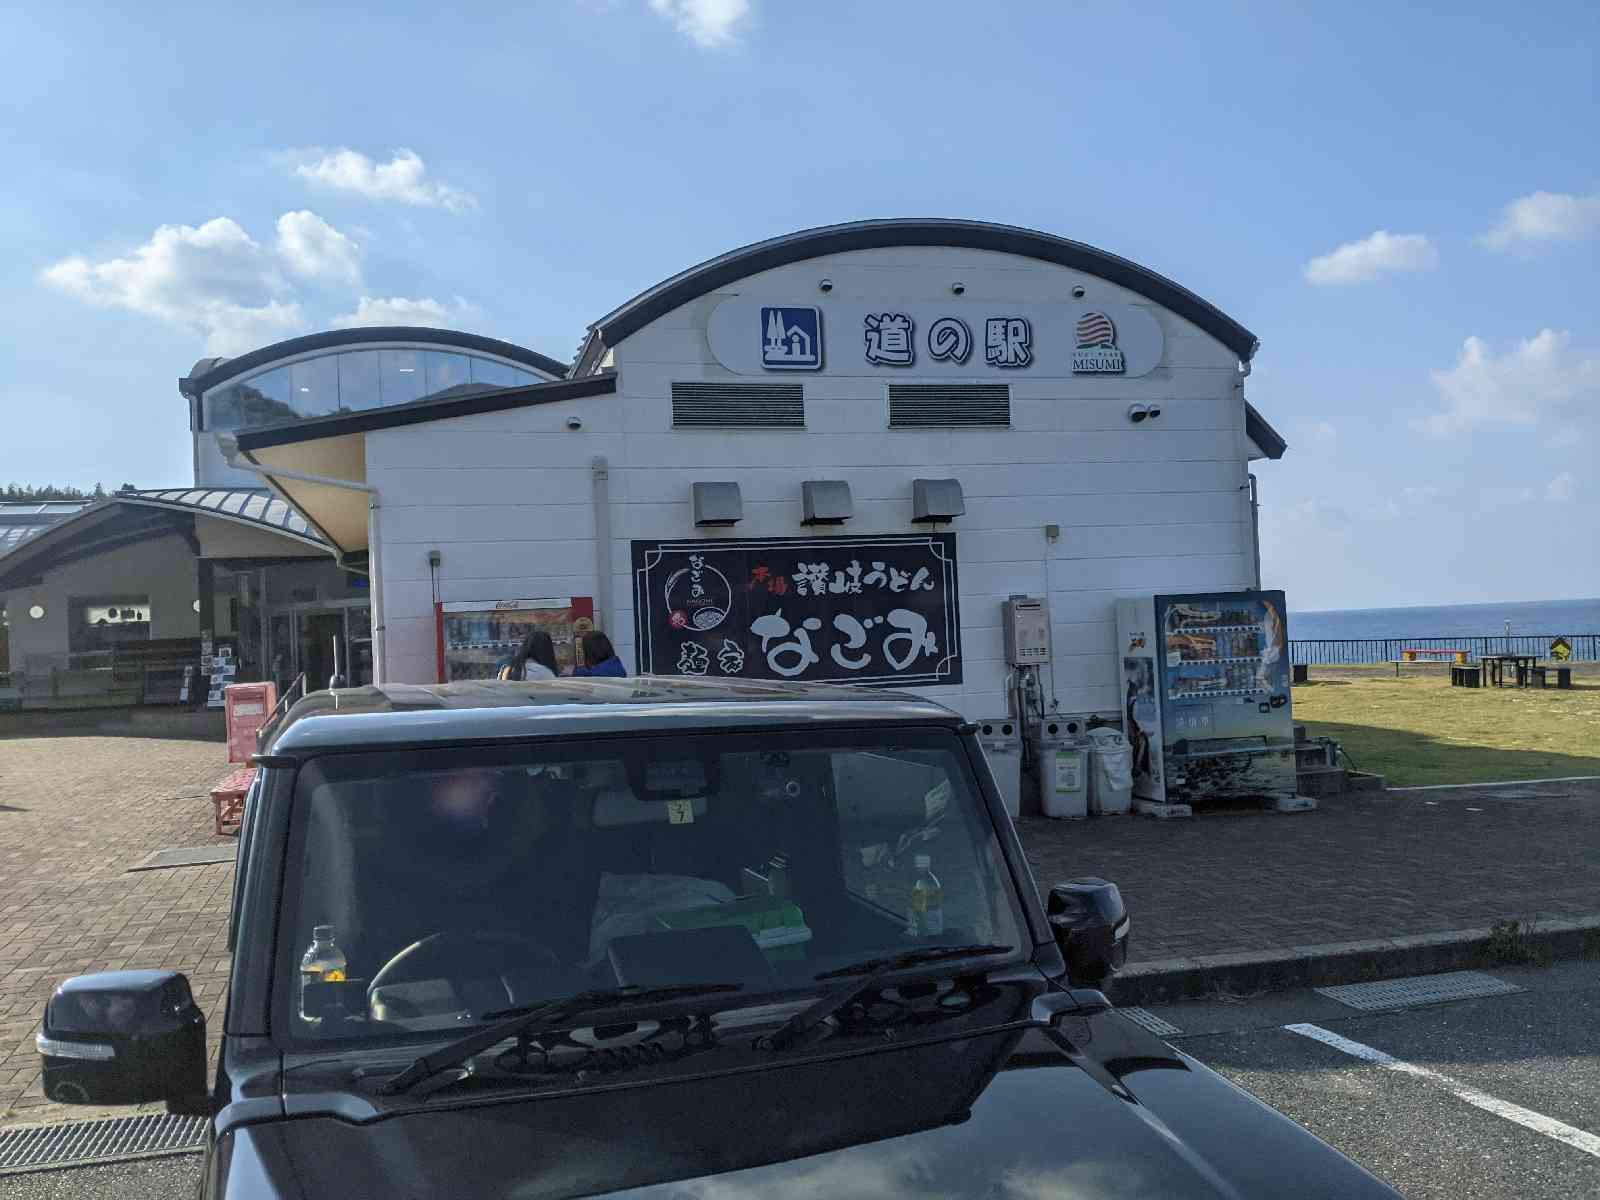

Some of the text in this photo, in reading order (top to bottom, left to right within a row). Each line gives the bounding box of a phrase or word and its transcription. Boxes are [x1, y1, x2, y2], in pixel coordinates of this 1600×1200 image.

[864, 313, 1032, 365] 道の駅
[1073, 358, 1120, 370] MISUMI
[749, 607, 939, 677] なごみ
